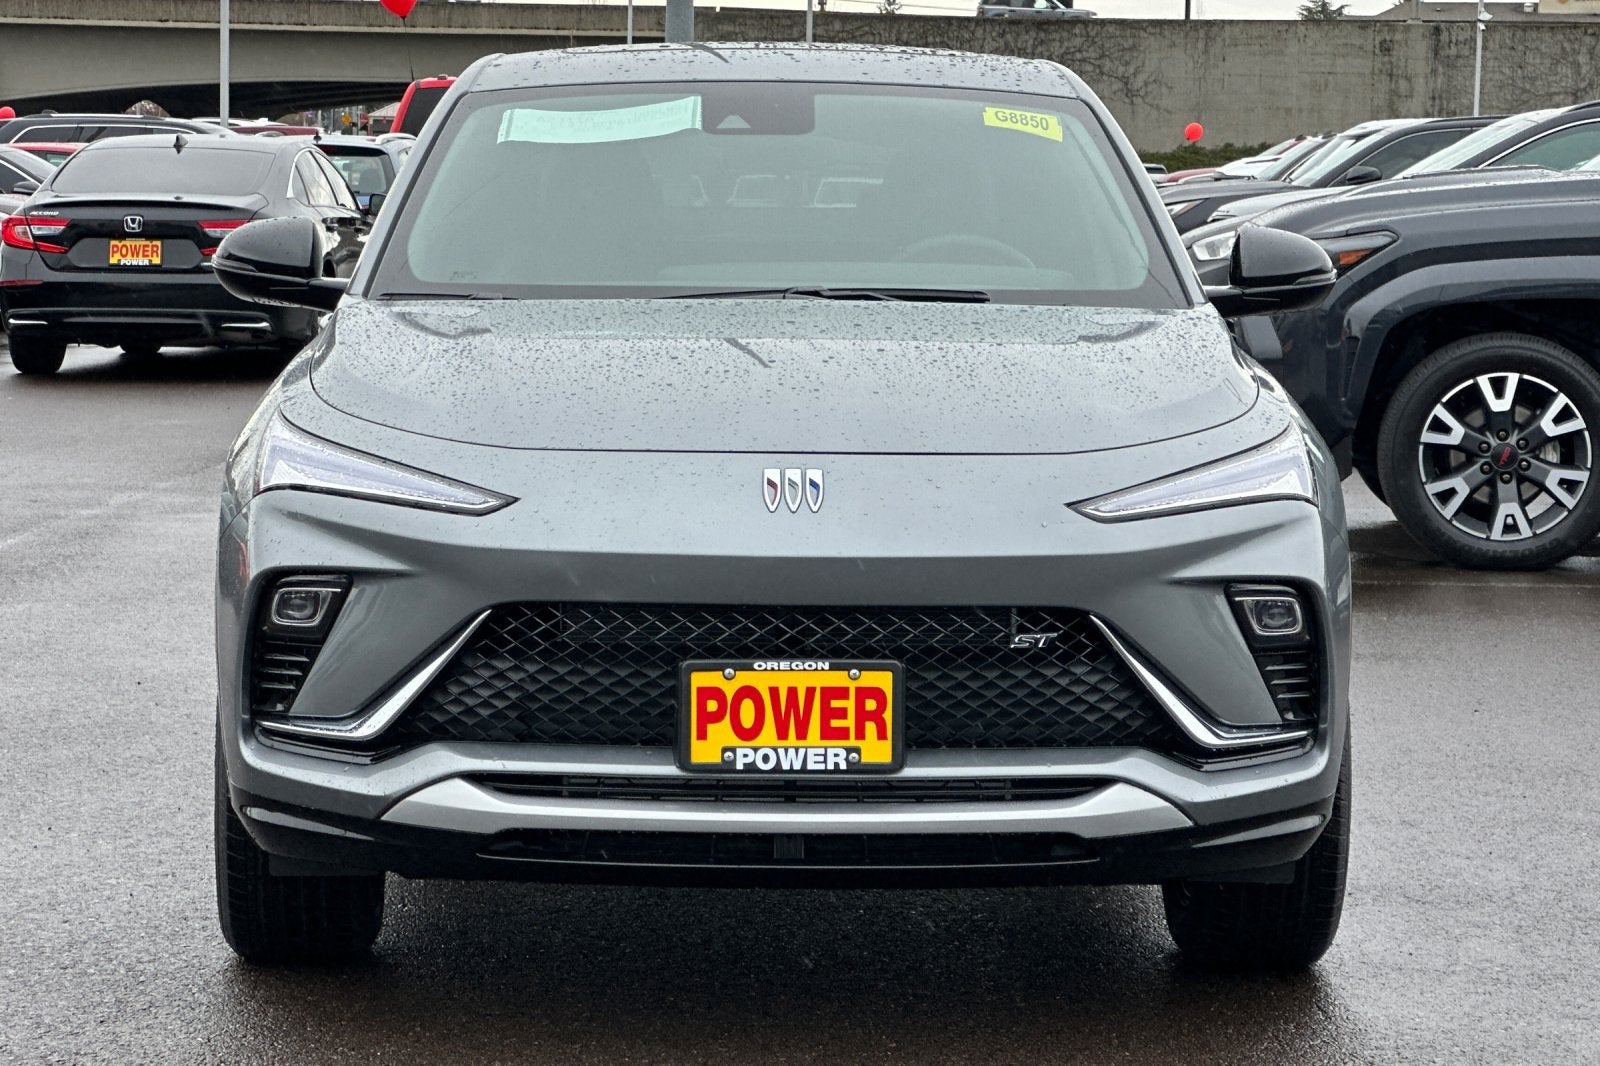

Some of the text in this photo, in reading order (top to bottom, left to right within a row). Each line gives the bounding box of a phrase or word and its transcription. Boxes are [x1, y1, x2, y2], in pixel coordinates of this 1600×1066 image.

[994, 110, 1049, 131] G8850
[111, 243, 160, 258] POWER
[1010, 632, 1058, 648] ST
[753, 661, 830, 671] OREGON
[696, 684, 888, 742] POWER
[735, 747, 847, 771] POWER
